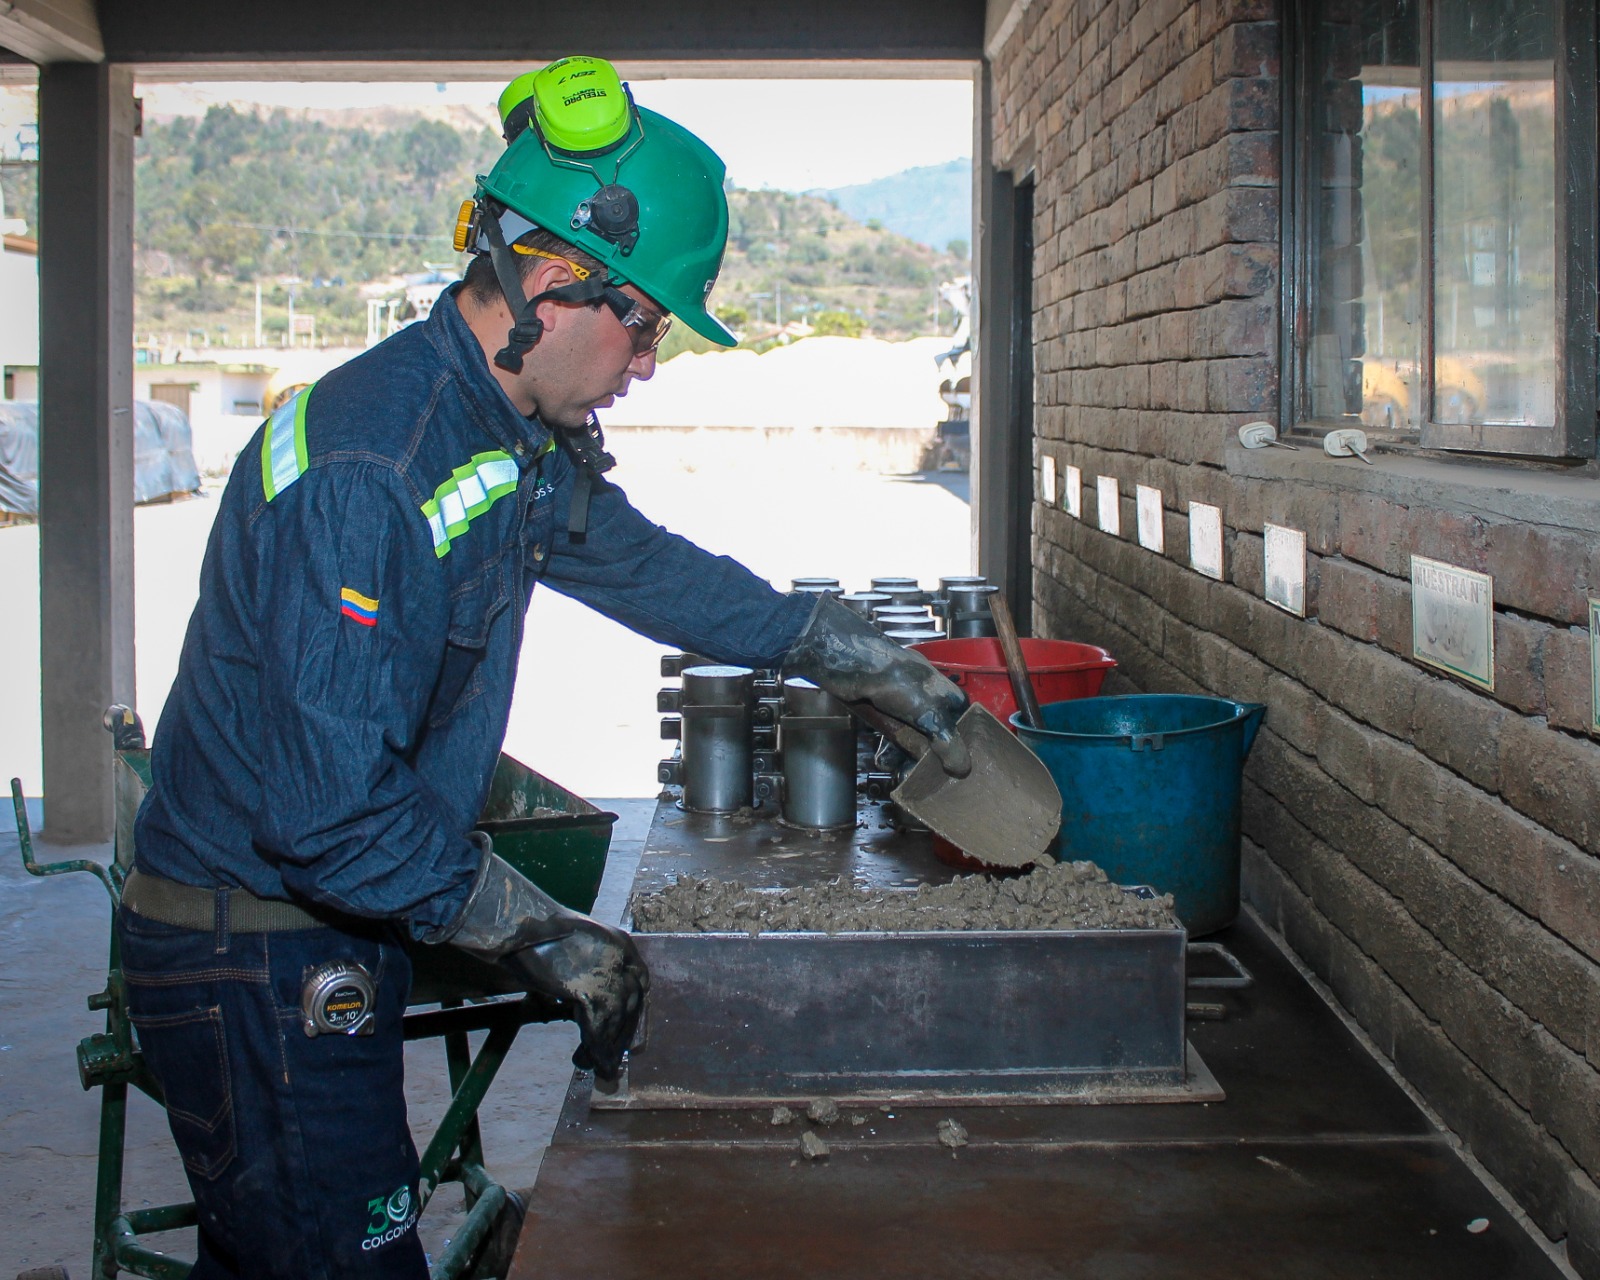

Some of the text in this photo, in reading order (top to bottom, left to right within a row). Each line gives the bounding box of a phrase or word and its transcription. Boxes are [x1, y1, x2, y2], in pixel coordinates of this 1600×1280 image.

[564, 91, 607, 107] STEELPRO
[1414, 565, 1468, 601] MUESTRA
[327, 1001, 361, 1012] KOMELON
